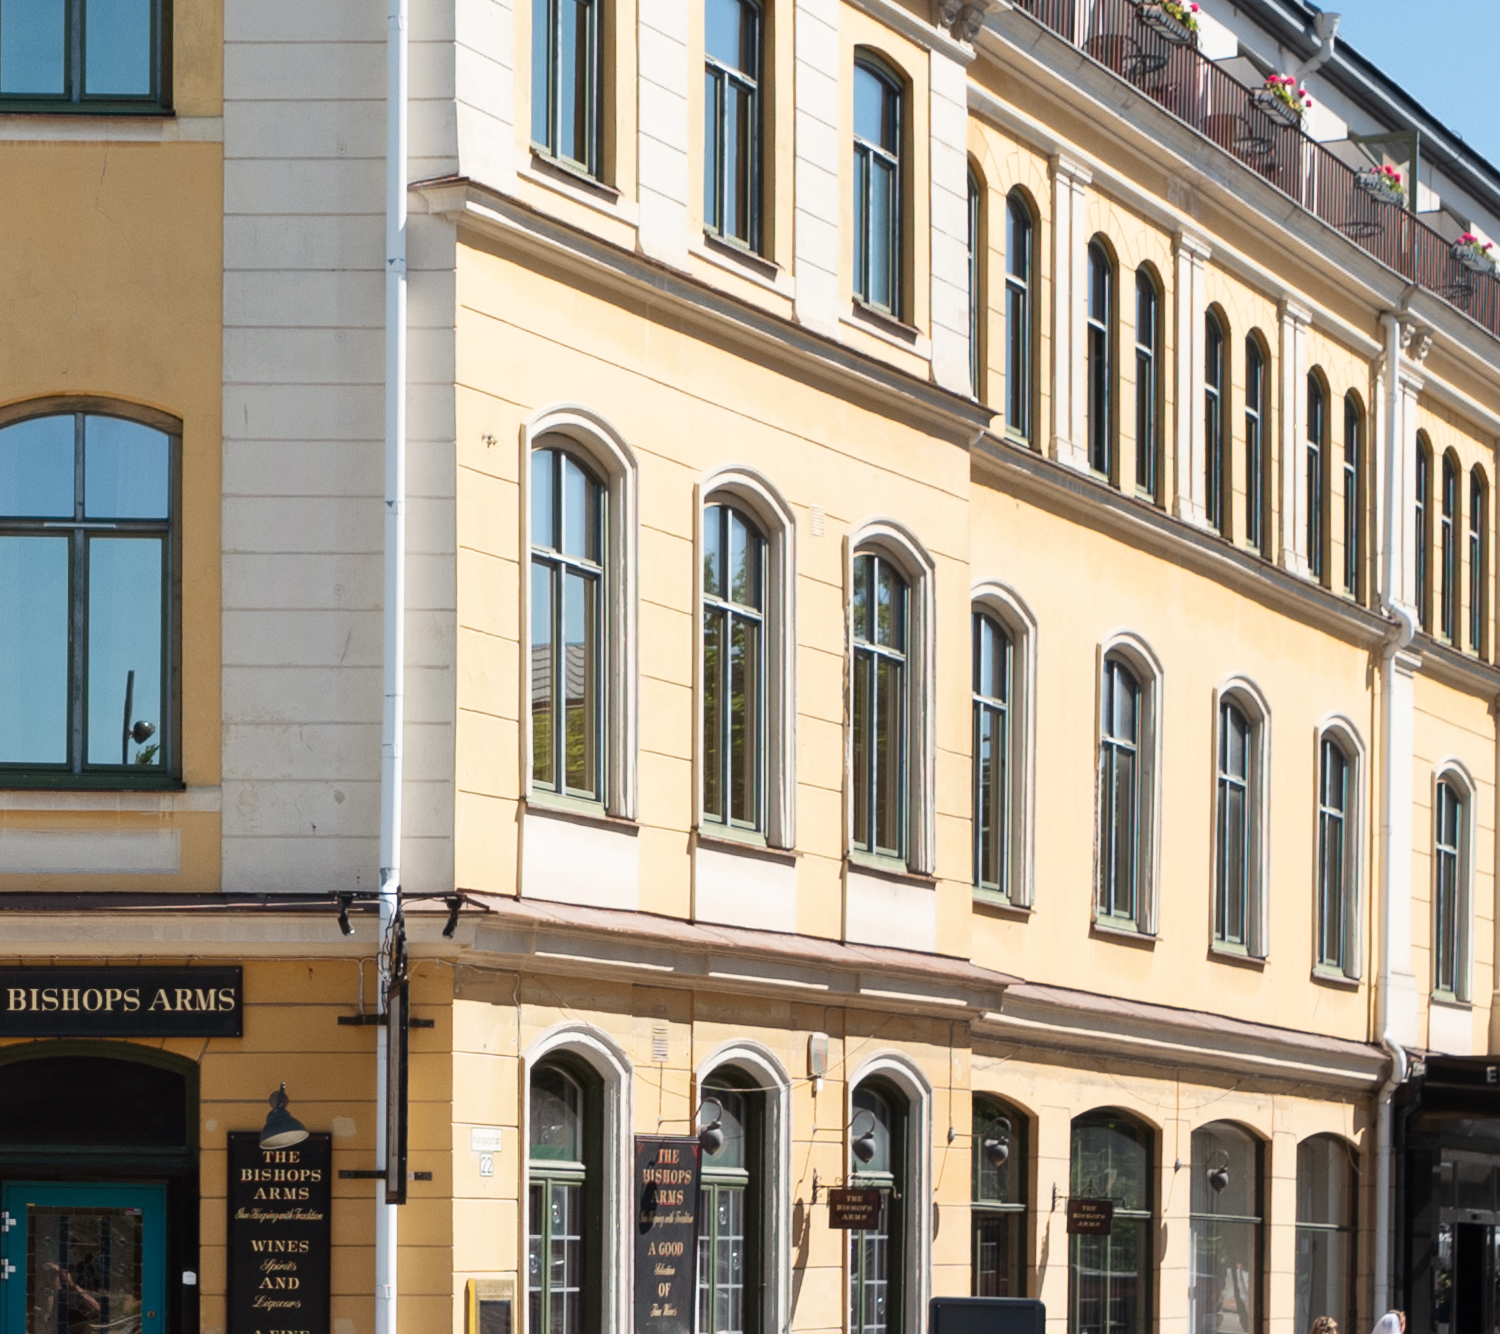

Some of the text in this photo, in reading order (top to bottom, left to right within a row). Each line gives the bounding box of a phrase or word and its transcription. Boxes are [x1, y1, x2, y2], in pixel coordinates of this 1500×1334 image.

[6, 987, 141, 1012] BISHOPS
[148, 987, 235, 1012] ARMS
[262, 1150, 300, 1163] THE
[658, 1149, 680, 1165] THE
[481, 1156, 493, 1174] 22
[240, 1168, 321, 1182] BISHOPS
[642, 1168, 692, 1185] BISHOPS
[253, 1187, 310, 1200] ARMS
[650, 1189, 684, 1206] ARMS
[251, 1239, 310, 1253] WINES
[648, 1241, 684, 1257] A GOOD
[258, 1277, 300, 1290] AND
[658, 1282, 671, 1298] OF
